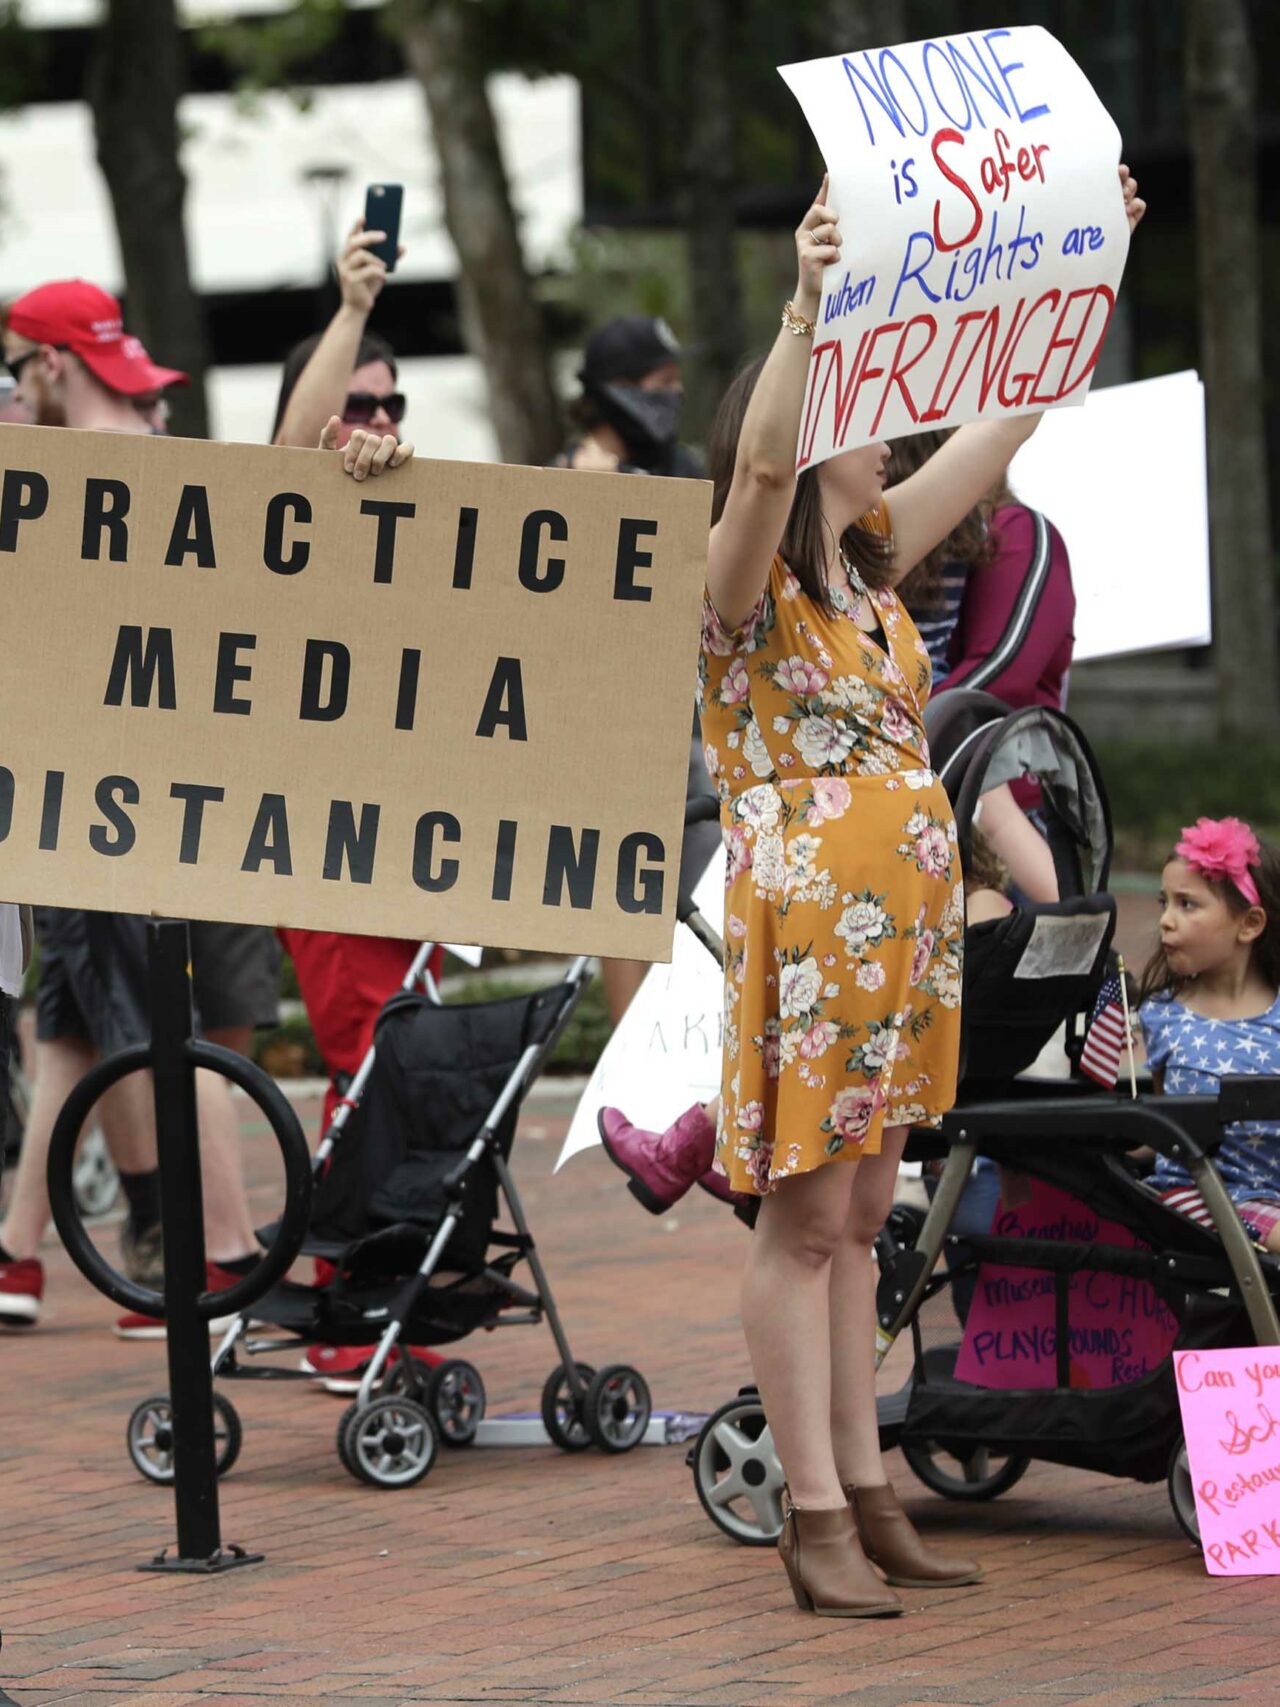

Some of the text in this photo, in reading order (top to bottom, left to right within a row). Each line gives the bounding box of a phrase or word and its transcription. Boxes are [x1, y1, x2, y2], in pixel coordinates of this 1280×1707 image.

[841, 29, 1051, 146] NO ONE
[890, 128, 1049, 253] is Safer
[824, 206, 1106, 324] when Rights are
[796, 283, 1116, 469] INFRINGED
[103, 625, 528, 741] MEDIA
[1177, 1353, 1236, 1393] Can
